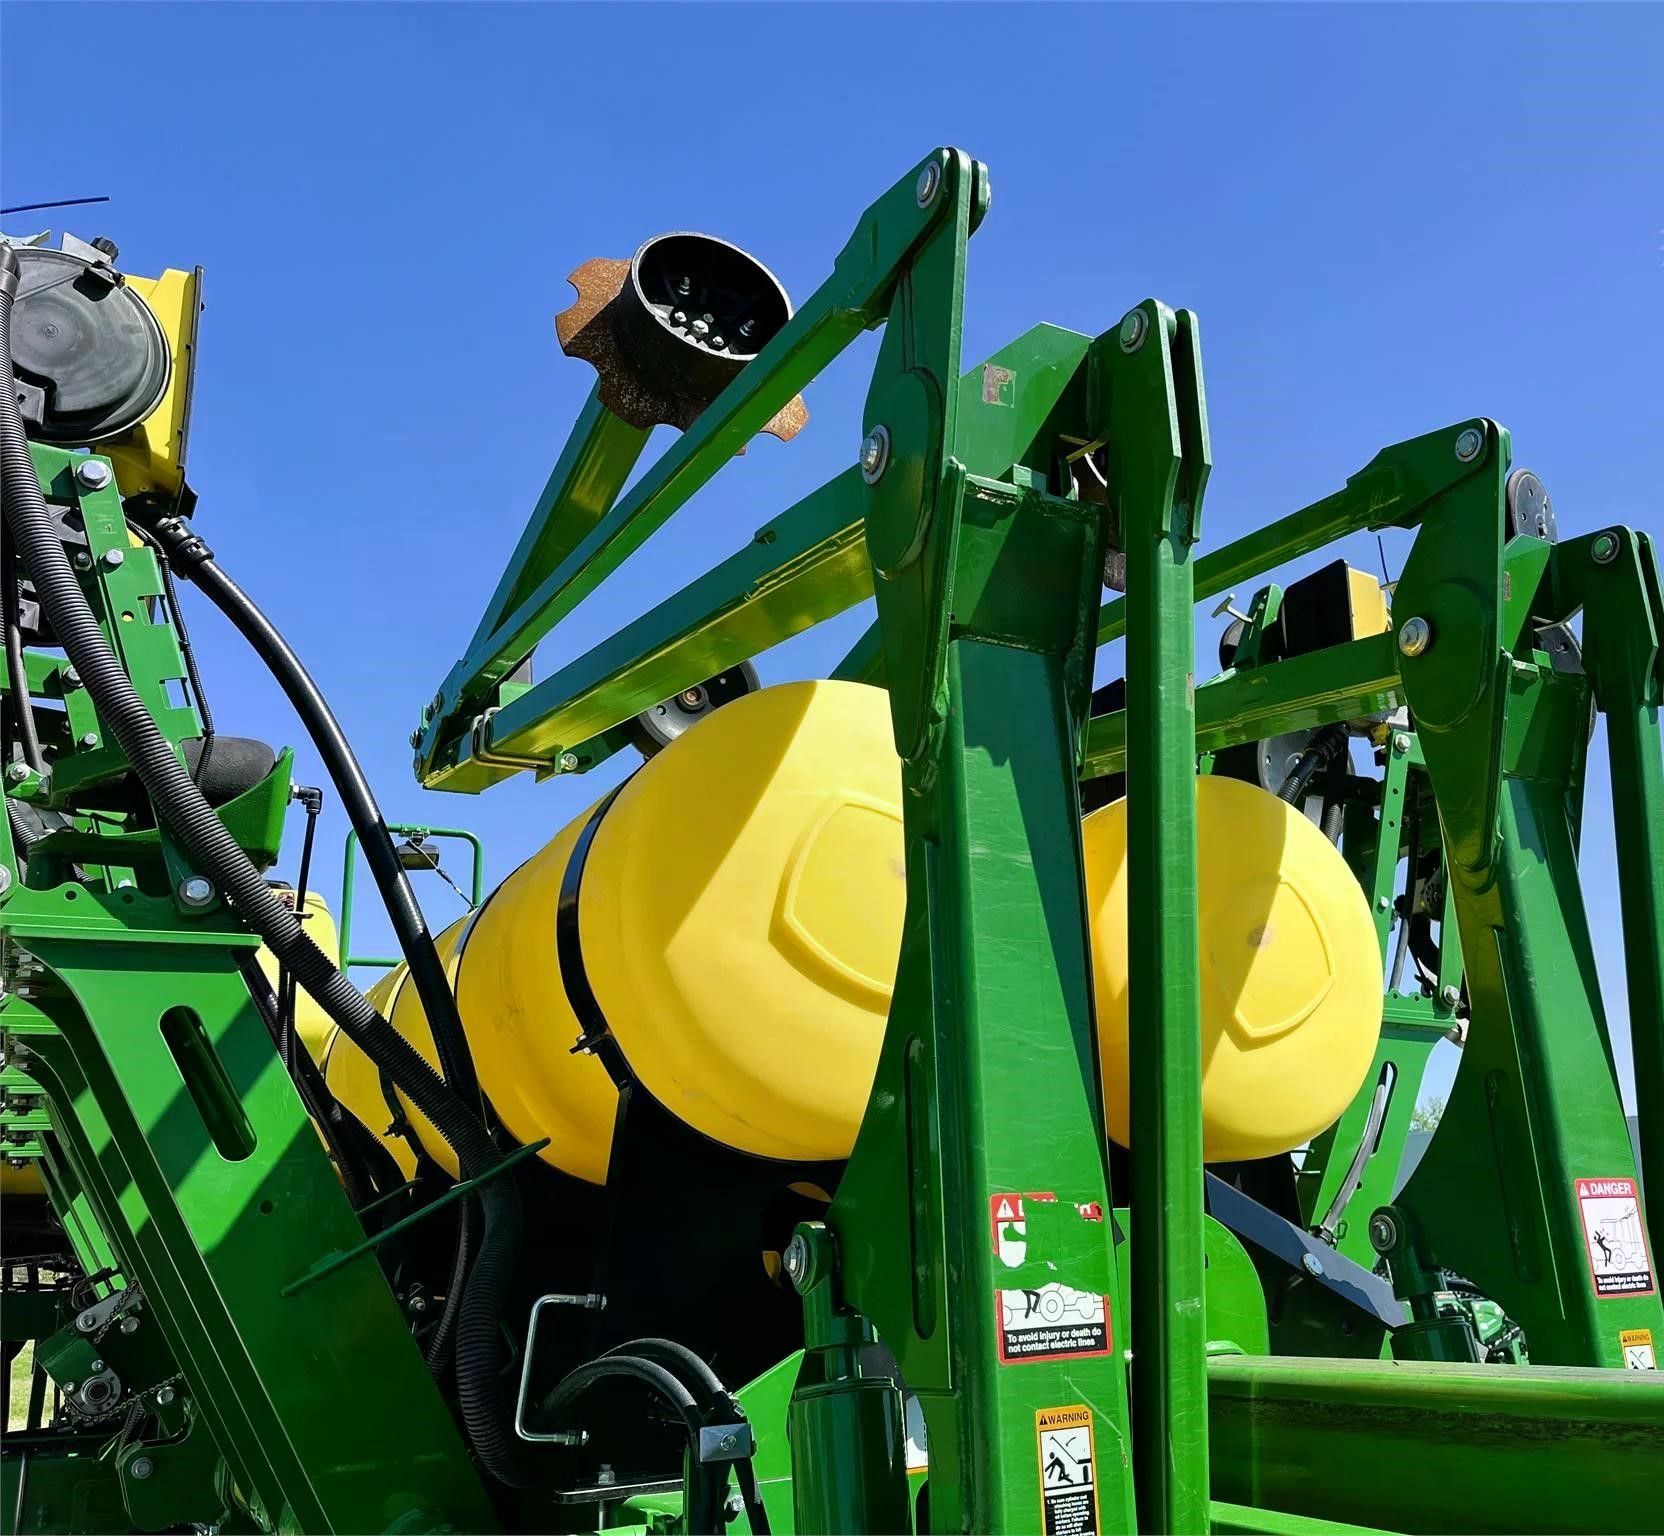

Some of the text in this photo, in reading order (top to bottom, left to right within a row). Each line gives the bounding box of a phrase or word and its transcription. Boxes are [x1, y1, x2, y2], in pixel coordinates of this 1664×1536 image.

[1590, 1182, 1632, 1196] DANGER
[1007, 1327, 1102, 1343] To avoid injury or death do
[1008, 1338, 1095, 1353] not contact electric lines
[1048, 1411, 1089, 1424] WARNING
